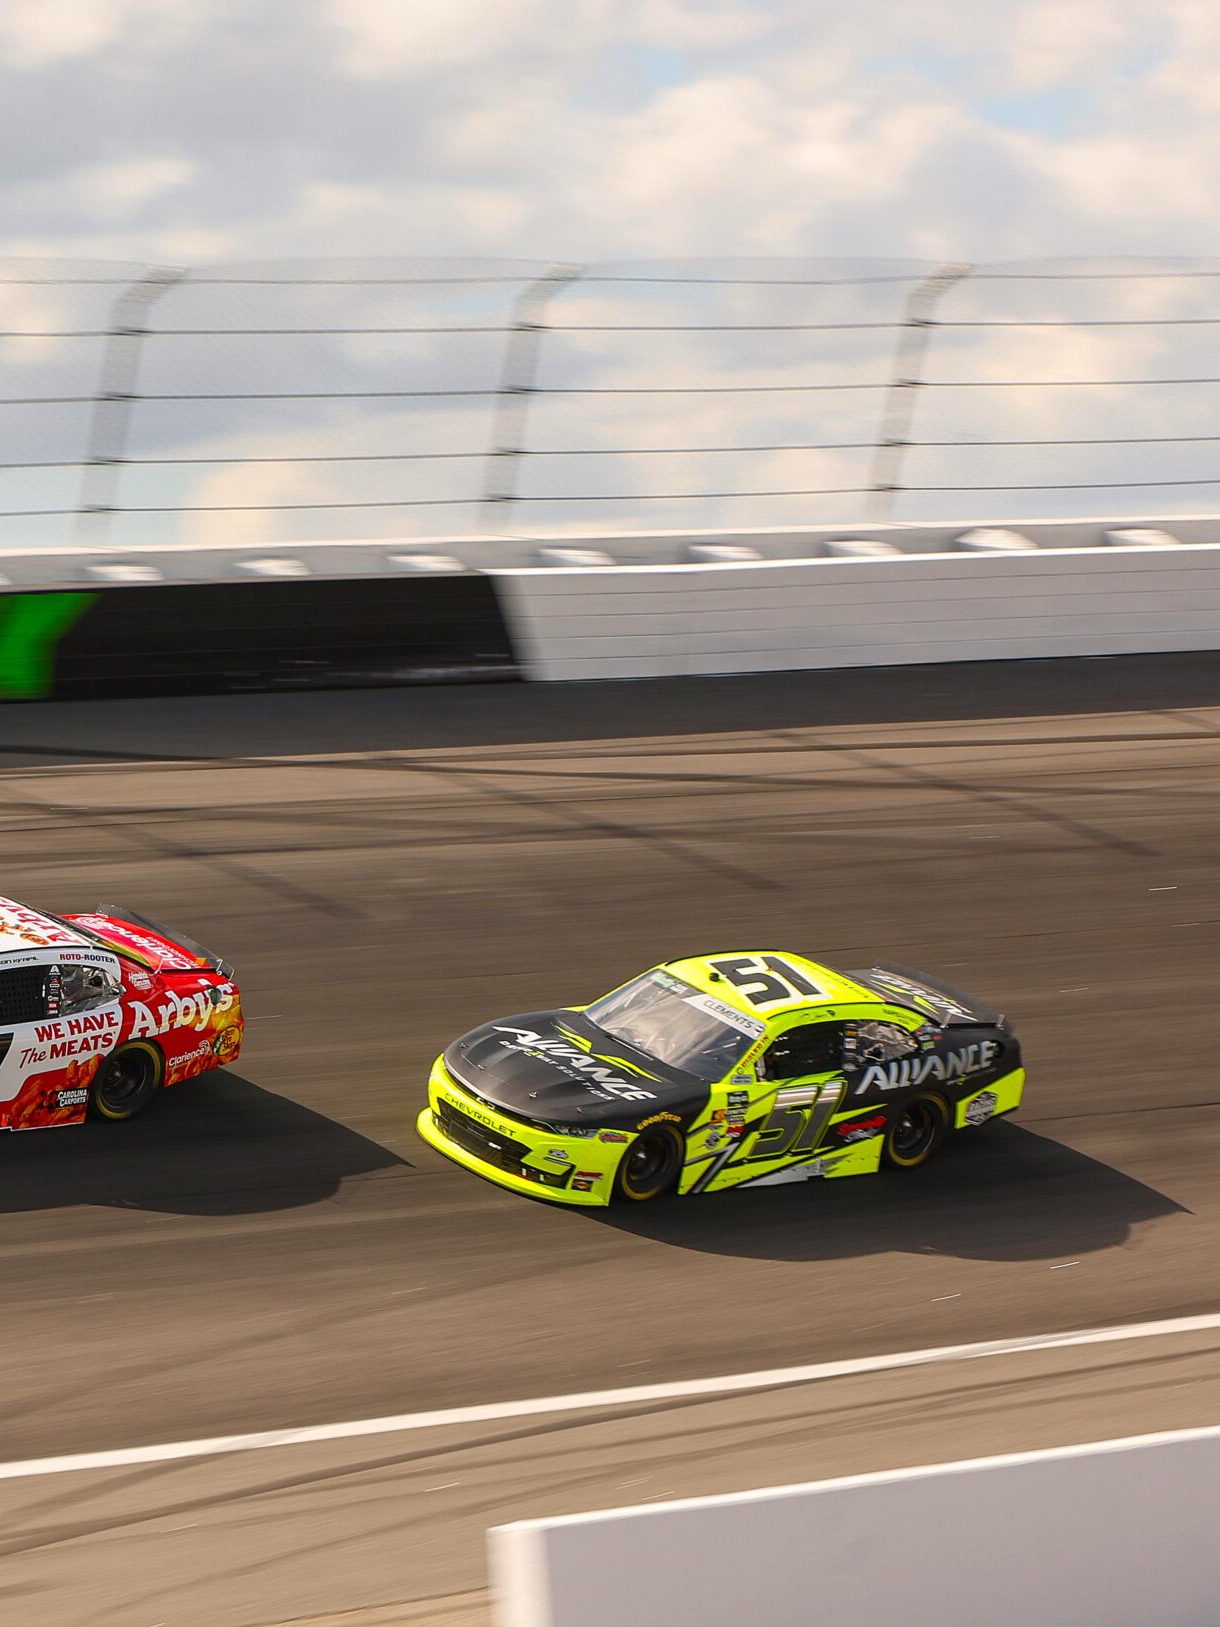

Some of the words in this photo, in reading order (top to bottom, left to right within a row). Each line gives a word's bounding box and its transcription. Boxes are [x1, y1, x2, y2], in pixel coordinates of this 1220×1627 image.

[59, 953, 116, 964] ROTO-ROOTER
[709, 955, 822, 1006] 51
[34, 1023, 65, 1043] WE
[66, 1011, 119, 1036] HAVE
[127, 979, 234, 1041] Arby's
[703, 999, 755, 1029] CLEMENTS
[20, 1047, 48, 1069] The
[49, 1031, 114, 1059] MEATS
[168, 1047, 205, 1067] Clarience
[492, 1025, 658, 1101] ALLIANCE
[854, 1040, 996, 1095] ALLIANCE
[58, 1088, 88, 1100] CAROLINA
[59, 1097, 86, 1107] CARPORTS
[444, 1092, 517, 1137] CHEVROLET
[748, 1079, 847, 1158] 51
